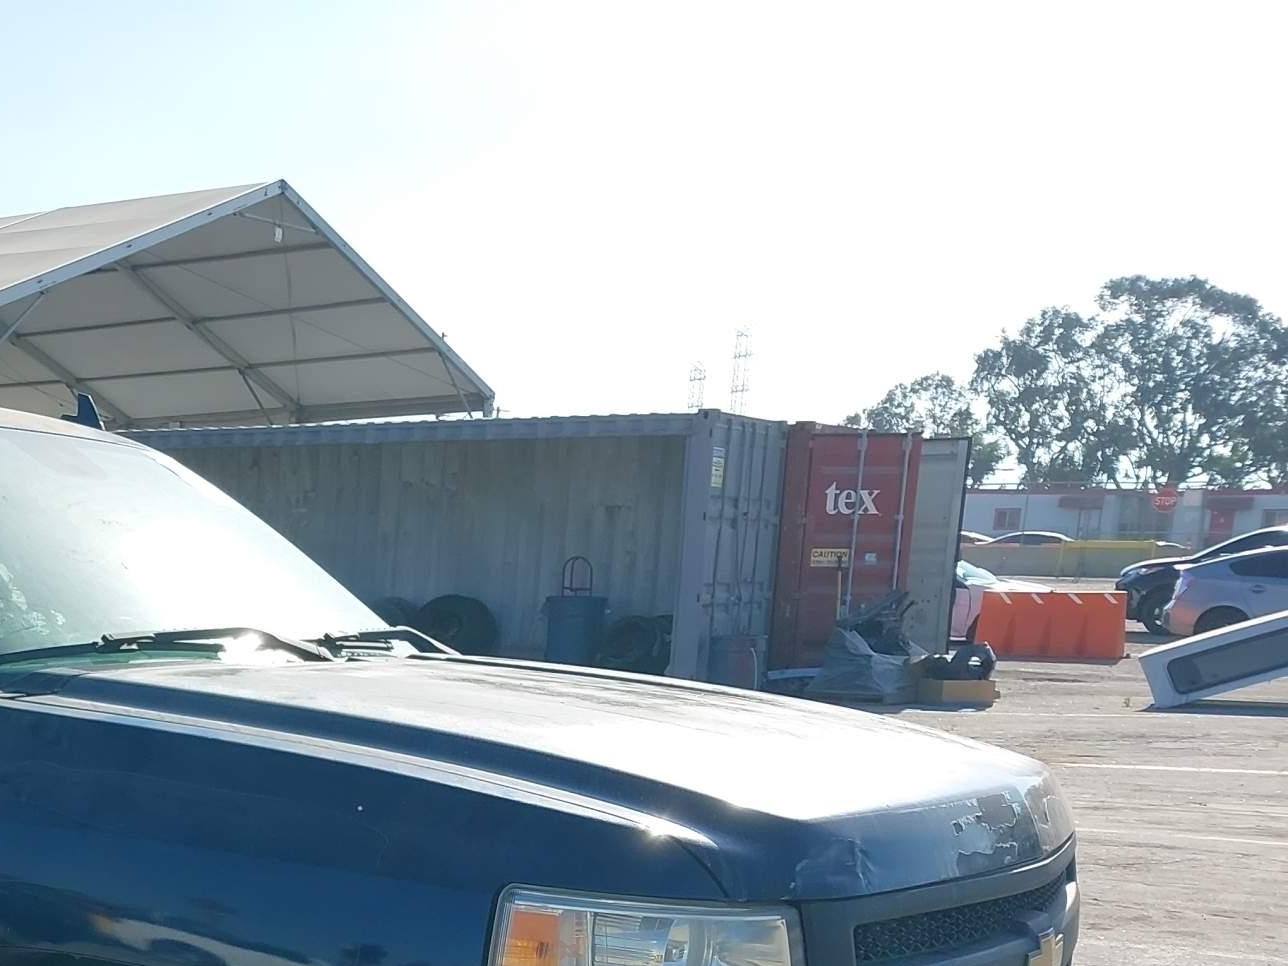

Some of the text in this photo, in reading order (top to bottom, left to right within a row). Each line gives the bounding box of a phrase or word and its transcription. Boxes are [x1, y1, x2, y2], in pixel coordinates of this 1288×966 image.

[824, 481, 881, 515] tex
[1154, 496, 1177, 506] STOP
[812, 550, 848, 559] CAUTION
